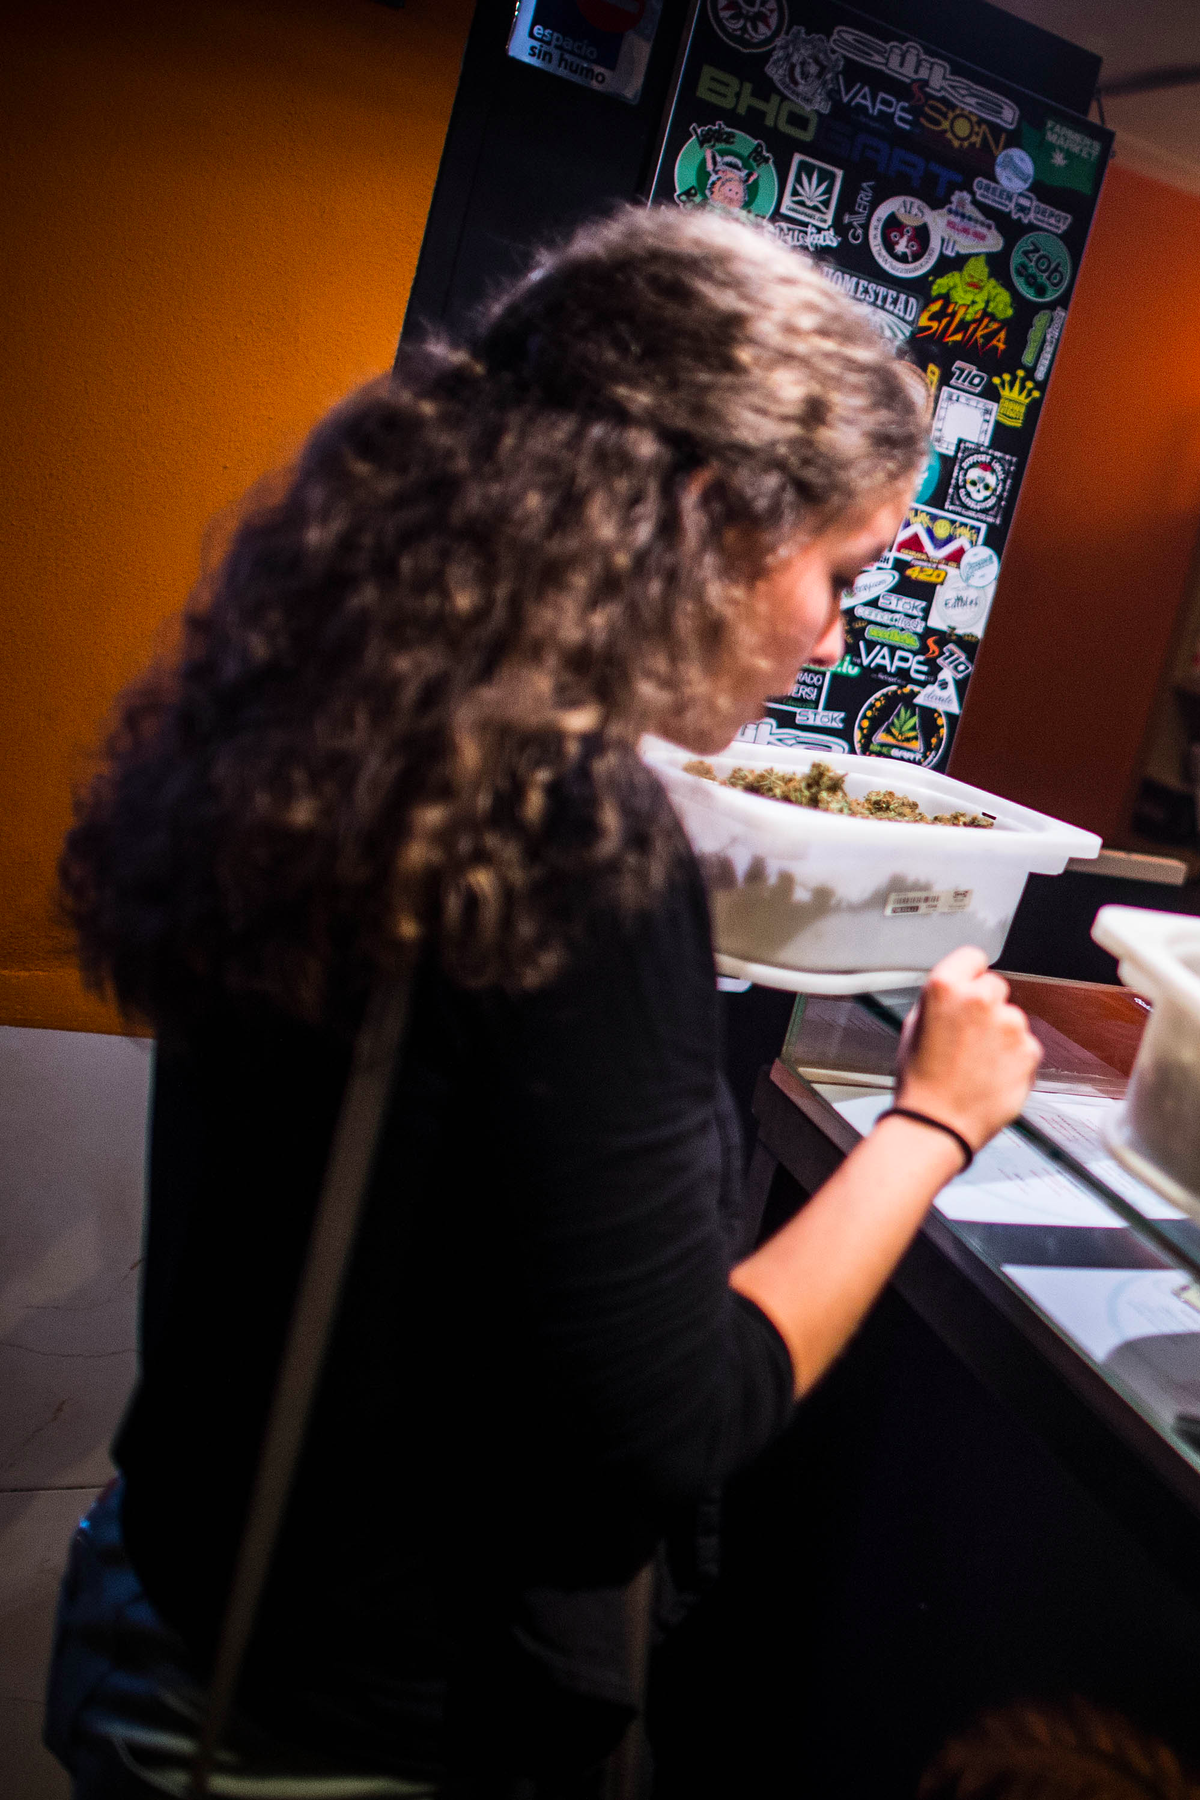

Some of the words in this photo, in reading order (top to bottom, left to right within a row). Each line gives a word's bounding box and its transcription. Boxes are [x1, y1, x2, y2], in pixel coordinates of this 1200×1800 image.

[532, 24, 598, 59] espacio
[528, 44, 553, 64] sin
[558, 53, 606, 84] humo
[838, 74, 913, 130] VAPE
[976, 181, 1013, 202] GREEN
[1034, 204, 1069, 226] DEPOT
[823, 266, 918, 322] HOMESTEAD
[906, 566, 947, 583] 420
[859, 640, 929, 680] VAPE
[796, 671, 823, 686] RADO
